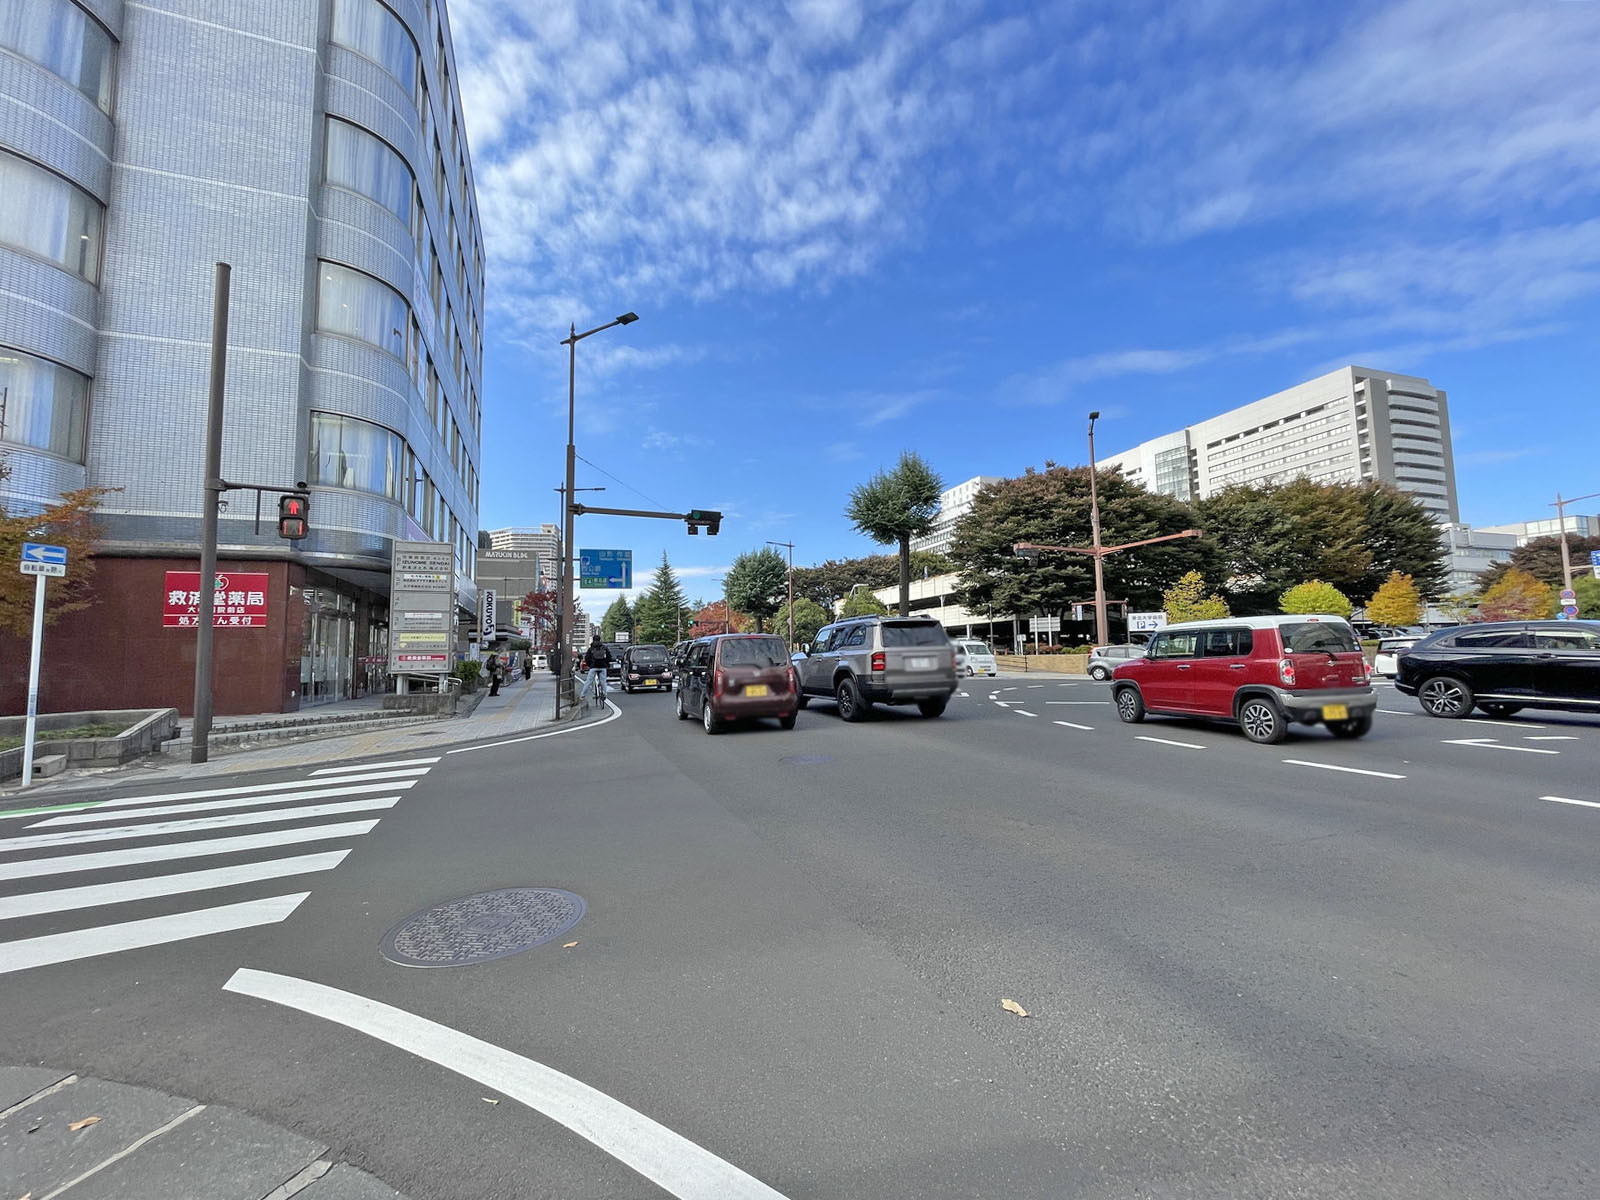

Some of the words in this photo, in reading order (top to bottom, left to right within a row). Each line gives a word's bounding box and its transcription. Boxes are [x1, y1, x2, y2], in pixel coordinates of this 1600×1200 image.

[485, 591, 494, 625] KOKUYO
[178, 616, 252, 626] 処方ん受付
